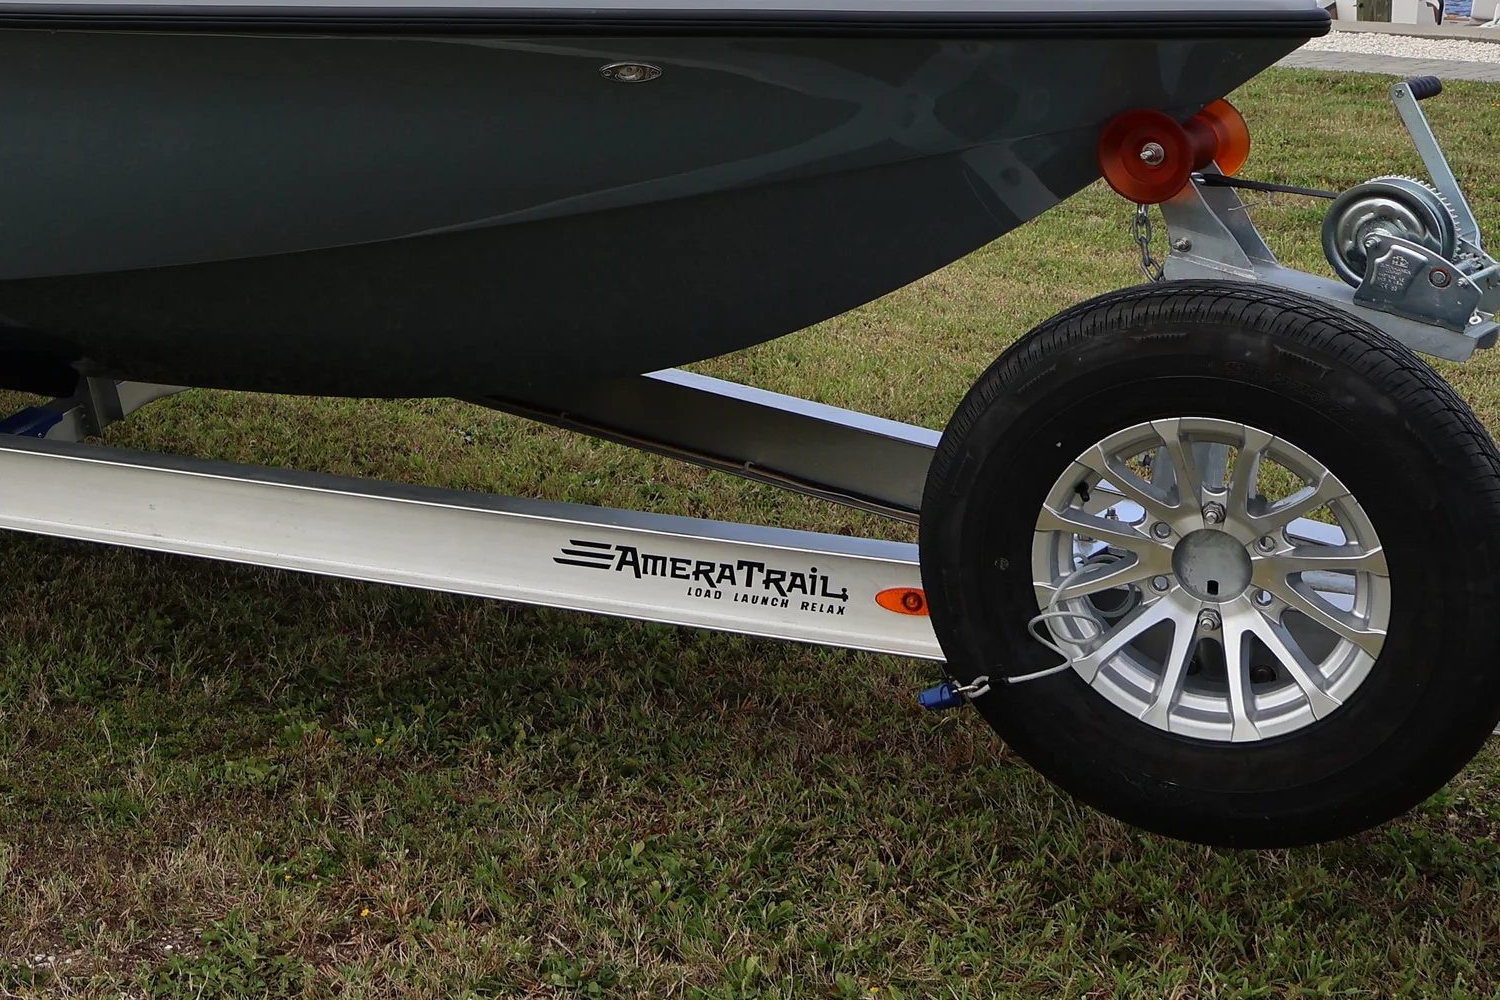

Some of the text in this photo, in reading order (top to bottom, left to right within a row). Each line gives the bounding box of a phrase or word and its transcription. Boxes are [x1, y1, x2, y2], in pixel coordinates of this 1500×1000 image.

[687, 586, 846, 616] LOAD LAUNCH RELAX
